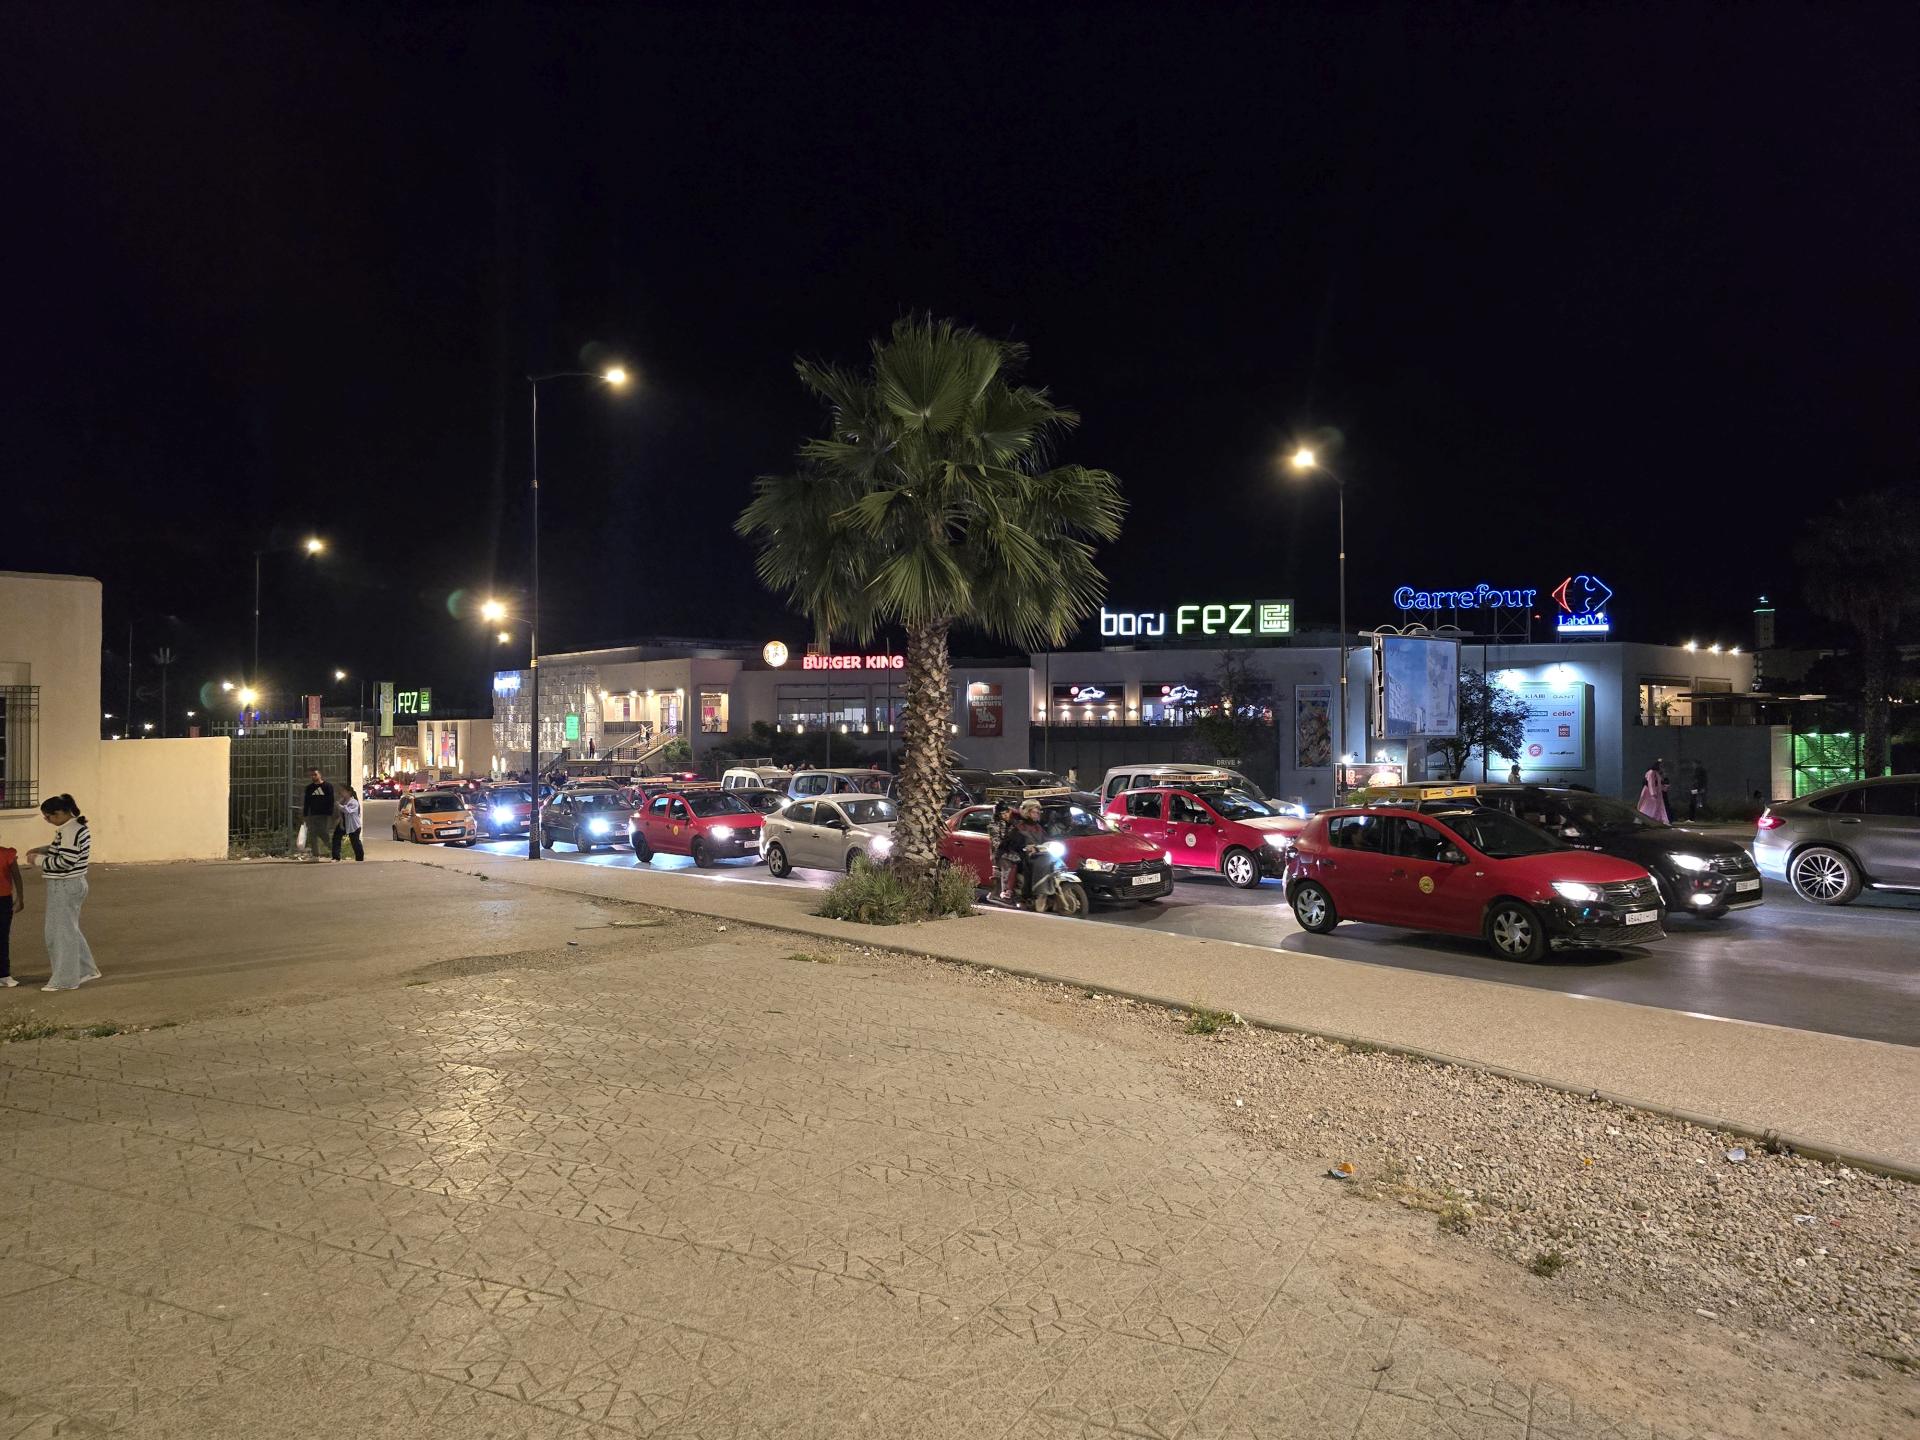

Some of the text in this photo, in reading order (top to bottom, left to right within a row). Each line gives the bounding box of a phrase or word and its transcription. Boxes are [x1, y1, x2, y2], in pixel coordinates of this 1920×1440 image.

[1394, 584, 1537, 609] Carrefour
[803, 655, 904, 669] BURGER KING
